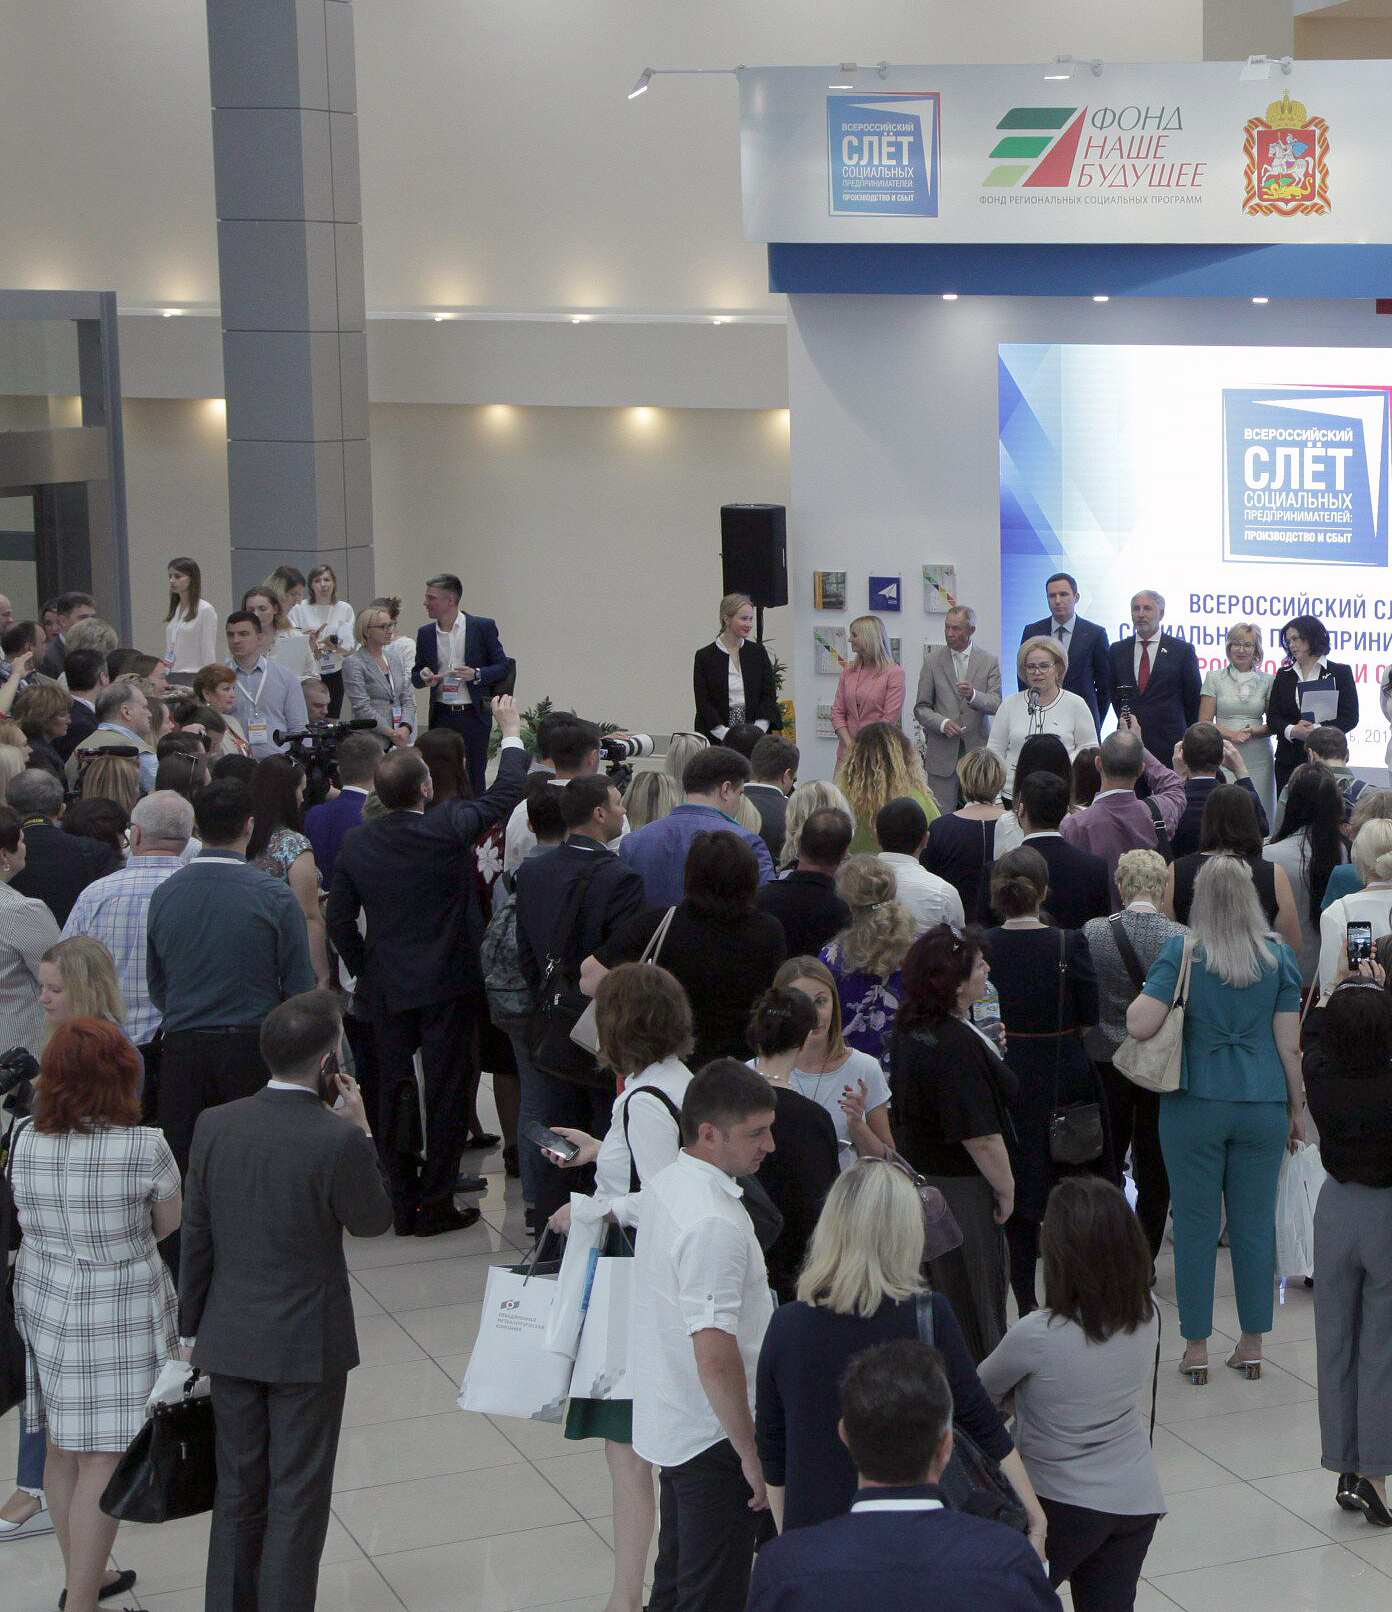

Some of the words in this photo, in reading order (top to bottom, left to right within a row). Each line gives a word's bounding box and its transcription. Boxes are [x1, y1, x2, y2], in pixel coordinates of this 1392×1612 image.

[841, 122, 914, 131] ВСЕРОССИЙСКИЙ
[1091, 106, 1183, 131] ФОНД
[842, 132, 914, 166] СЛЁТ
[1083, 135, 1169, 160] НАШЕ
[842, 167, 914, 179] СОЦИАЛЬНЫХ
[1077, 163, 1207, 188] БУДУЩЕЕ
[842, 193, 891, 202] ПРОИЗВОДСТВО
[979, 196, 1007, 206] ФОНД
[1009, 196, 1083, 205] РЕГИОНАЛЬНЫХ
[1084, 196, 1149, 205] СОЦИАЛЬНЫХ
[1151, 196, 1202, 205] ПРОГРАММ
[1244, 427, 1353, 442] ВСЕРОССИЙСКИЙ
[1244, 441, 1354, 491] СЛЁТ
[1244, 490, 1353, 510] СОЦИАЛЬНЫХ
[1244, 509, 1353, 524] ПРЕДПРИНИМАТЕЛЕЙ:
[1244, 530, 1316, 544] ПРОИЗВОДСТВО
[1317, 532, 1325, 543] И
[1325, 532, 1353, 544] СБЫТ
[1189, 592, 1367, 619] ВСЕРОССИЙСКИЙ
